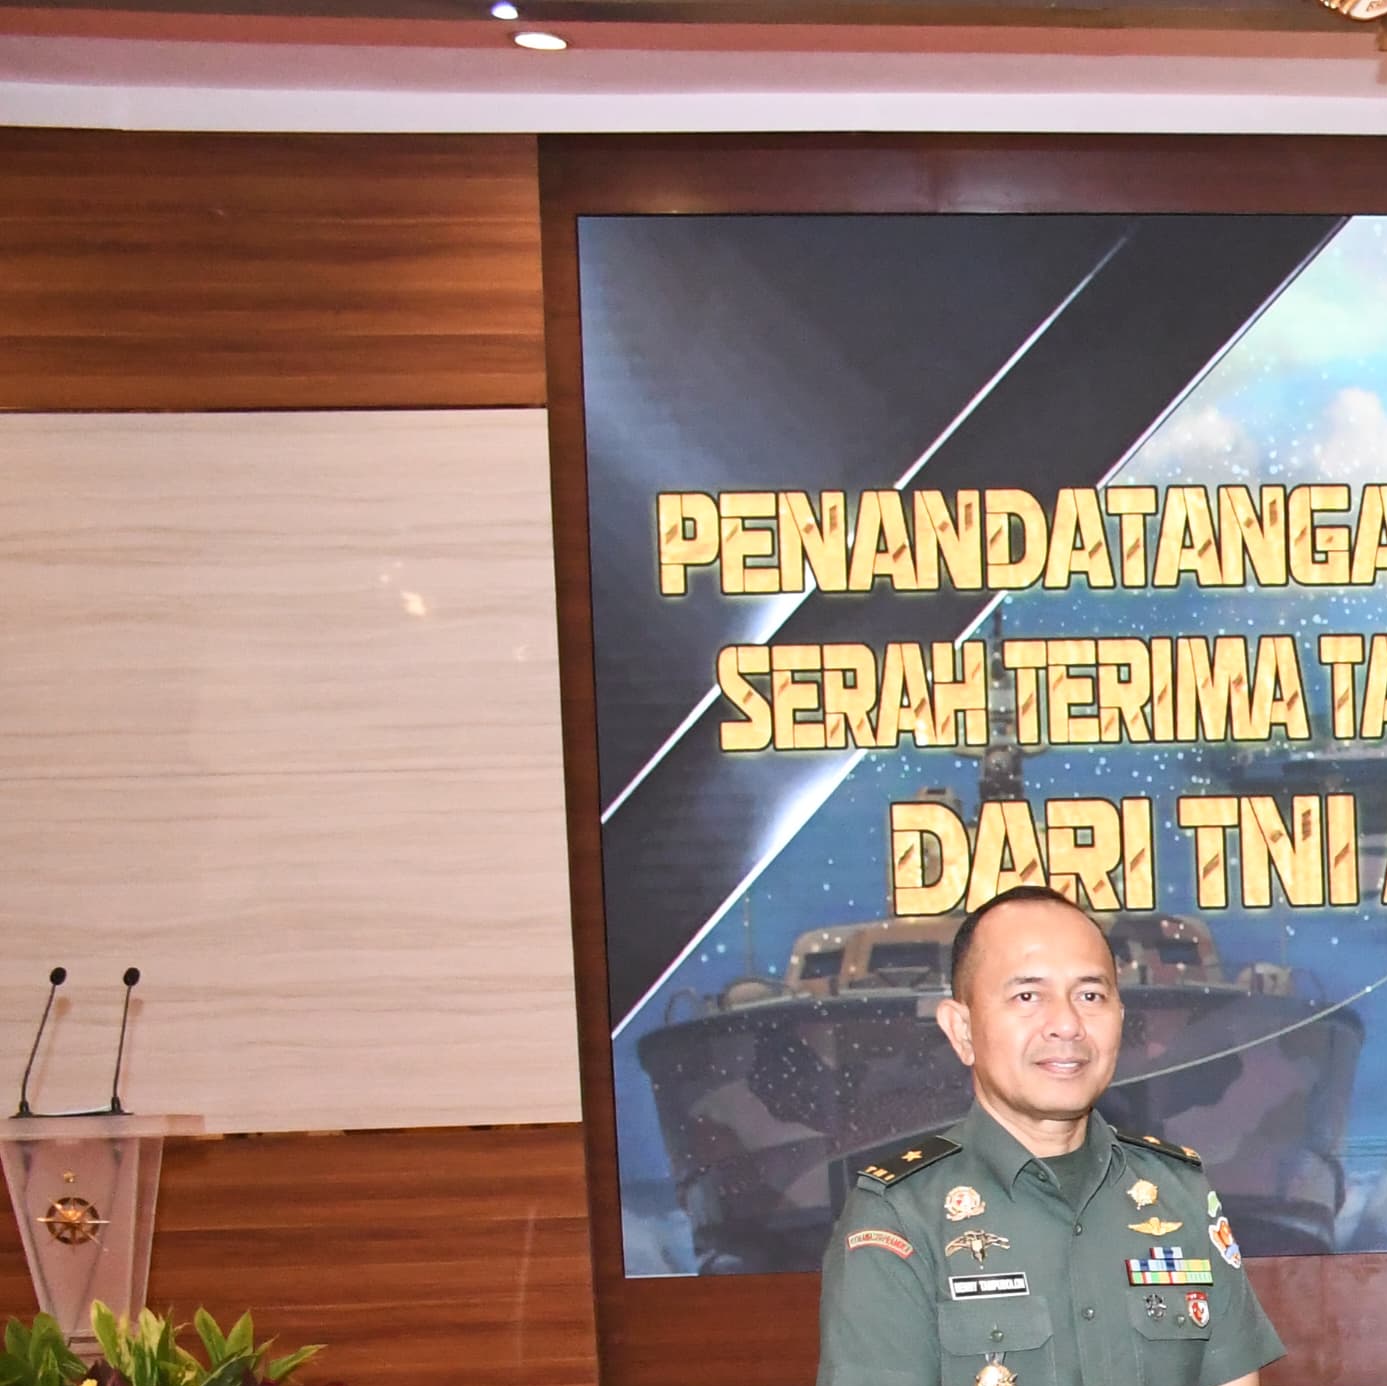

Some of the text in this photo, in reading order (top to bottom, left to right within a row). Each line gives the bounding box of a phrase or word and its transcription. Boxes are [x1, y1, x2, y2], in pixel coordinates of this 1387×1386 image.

[716, 639, 989, 753] SERAH
[1004, 634, 1310, 748] TERIMA
[890, 796, 1157, 917] DARI
[1178, 791, 1360, 909] TNI
